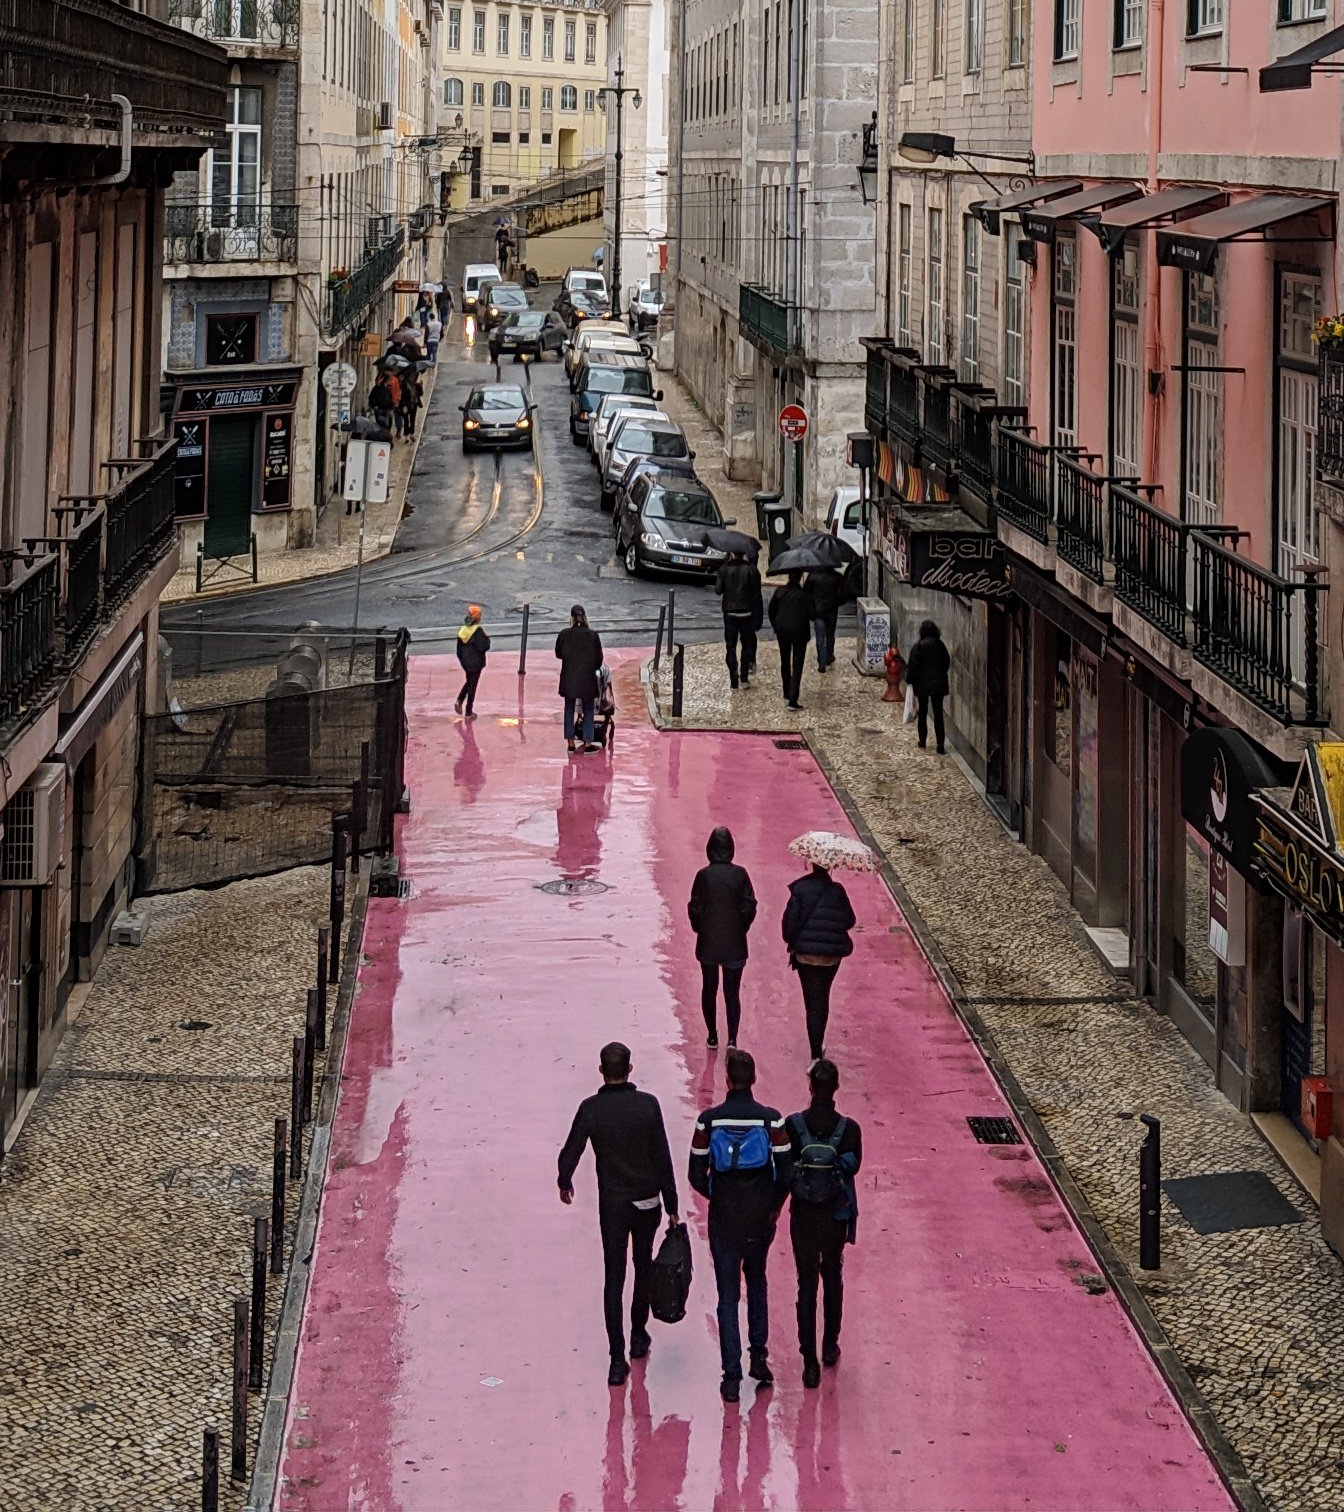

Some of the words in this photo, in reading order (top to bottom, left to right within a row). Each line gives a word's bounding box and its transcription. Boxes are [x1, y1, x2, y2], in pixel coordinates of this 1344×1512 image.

[929, 534, 1007, 559] bar
[1298, 787, 1320, 826] BAR
[1285, 842, 1334, 914] OSLO
